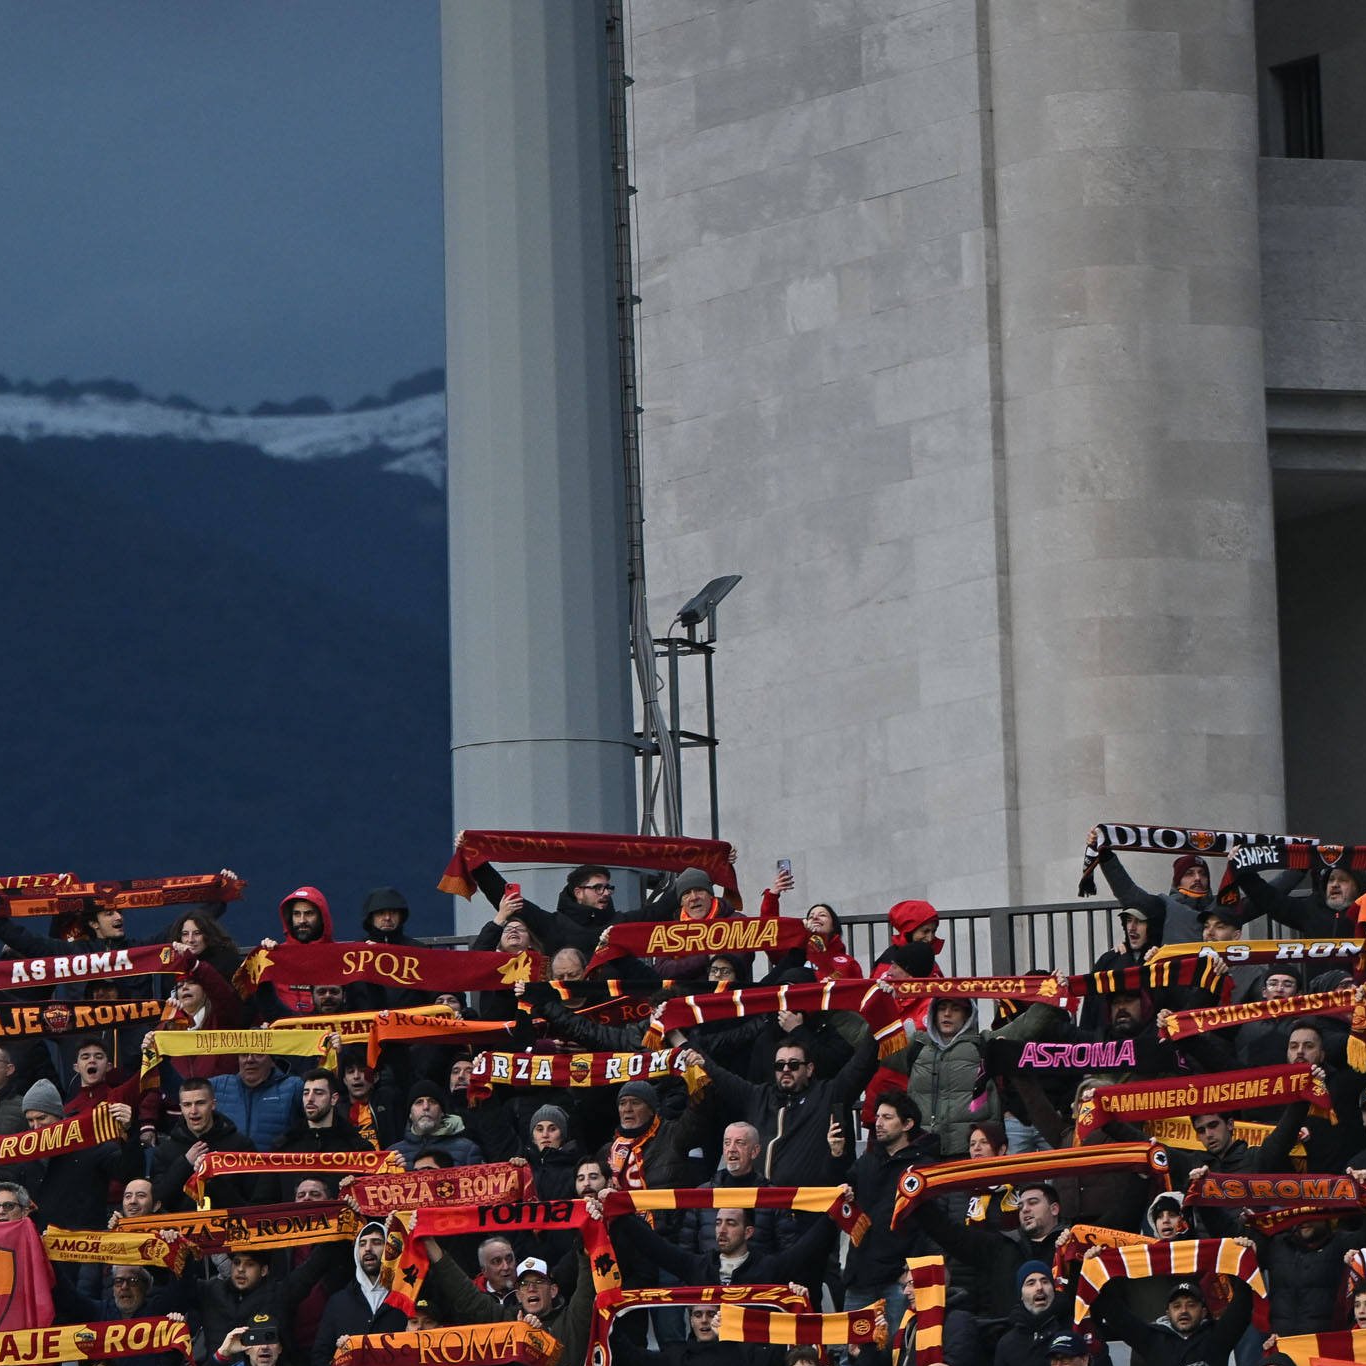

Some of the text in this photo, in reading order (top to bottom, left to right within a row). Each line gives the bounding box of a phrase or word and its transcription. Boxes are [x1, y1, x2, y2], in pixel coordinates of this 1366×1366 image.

[1236, 845, 1280, 869] SEMPRE
[11, 949, 134, 983] AS ROMA
[342, 951, 424, 983] SPQR
[1199, 945, 1251, 961] AS
[74, 1000, 161, 1027] ROMA
[196, 1032, 273, 1052] DAJE ROMA DAJE
[606, 1048, 687, 1082] ROMA
[1101, 1078, 1267, 1113] CAMMINERÒ INSIEME
[0, 1119, 83, 1155] ROMA
[210, 1152, 377, 1168] ROMA CLUB COMO
[363, 1182, 433, 1209] FORZA
[458, 1169, 522, 1199] ROMA
[256, 1203, 333, 1238] ROMA
[477, 1199, 573, 1227] roma
[416, 1327, 519, 1366] ROMA
